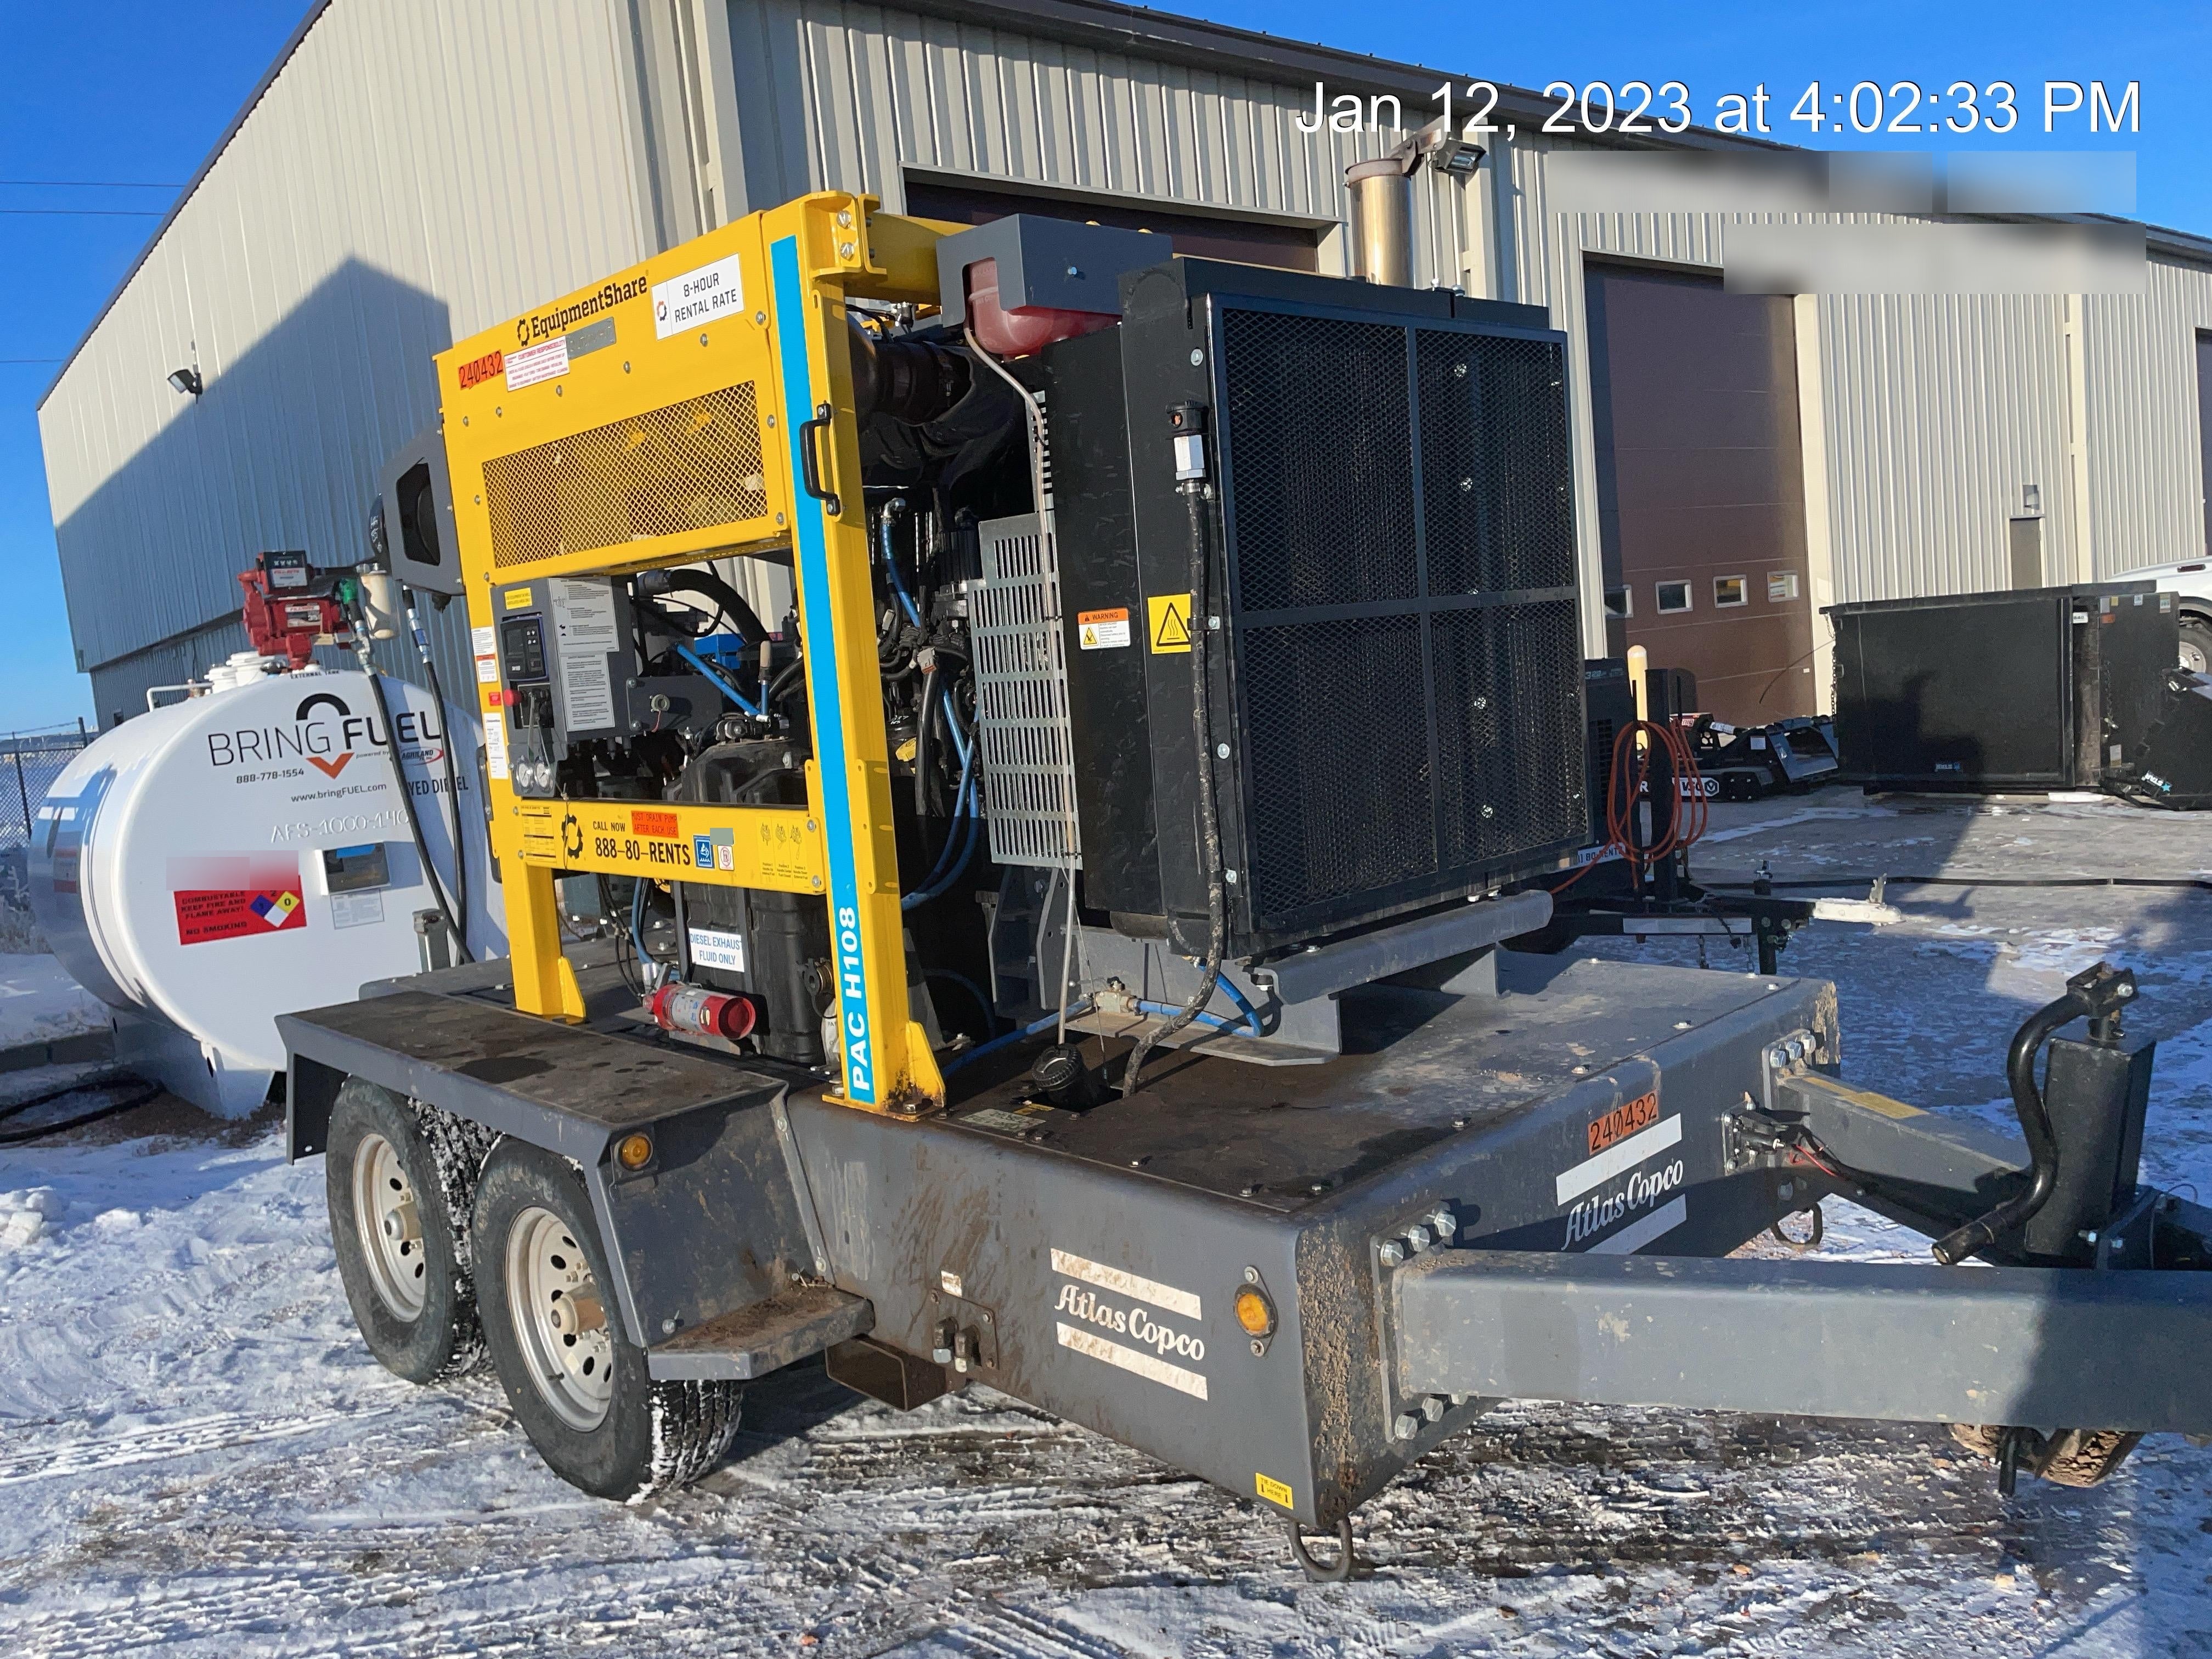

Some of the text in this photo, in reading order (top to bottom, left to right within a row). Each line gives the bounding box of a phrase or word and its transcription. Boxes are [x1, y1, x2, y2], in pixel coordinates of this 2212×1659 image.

[683, 272, 720, 297] 8-HOUR
[531, 275, 647, 338] EquipmentShare
[674, 289, 737, 323] RENTAL RATE
[459, 351, 504, 387] 240432
[1092, 612, 1119, 620] WARNING
[208, 721, 331, 766] BRING
[342, 711, 441, 751] FUEL
[356, 751, 381, 759] powered
[236, 768, 304, 784] 888-778-1554
[291, 782, 387, 802] www.bringFUEL.com
[408, 776, 469, 797] YED DIEEL
[646, 813, 662, 822] DRAIN
[664, 814, 677, 823] PUMP
[592, 821, 625, 832] CALL NOW
[634, 823, 677, 835] AFTER EACH USE
[595, 837, 691, 866] 888-80-RENTS
[180, 898, 246, 912] KEEP FIRE AND
[284, 898, 291, 906] 0
[185, 906, 244, 919] FLAME AWAY!
[203, 921, 247, 934] SMOKING
[690, 933, 712, 946] DIESEL
[699, 950, 736, 966] FLUID ONLY
[839, 907, 870, 1091] PAC H108
[1590, 1092, 1657, 1152] 240432
[1560, 1159, 1683, 1251] Atlas Copco
[1054, 1284, 1205, 1361] Atlas Copco
[1260, 1477, 1288, 1493] TIE DOWN
[1266, 1487, 1282, 1499] HERE
